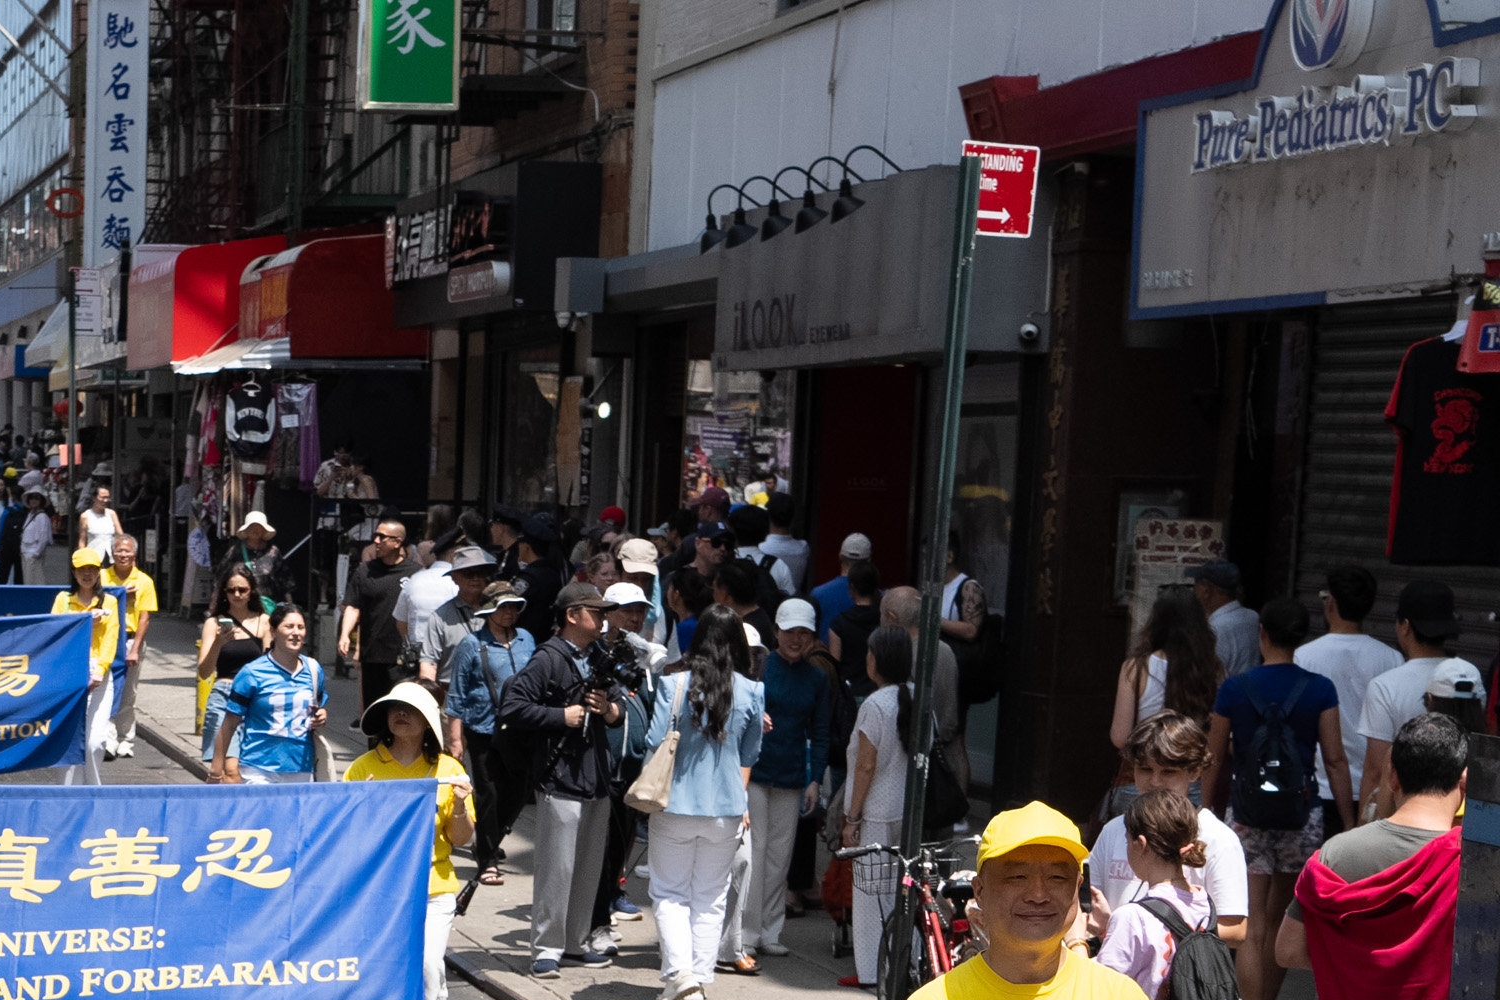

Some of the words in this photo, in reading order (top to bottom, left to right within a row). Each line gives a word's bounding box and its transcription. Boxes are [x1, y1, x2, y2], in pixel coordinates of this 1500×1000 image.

[101, 12, 139, 250] 馳名雲吞麵
[1192, 108, 1250, 172] Pure
[1403, 58, 1460, 134] PC
[980, 152, 1024, 173] STANDING
[79, 956, 361, 998] FORBEARANCE
